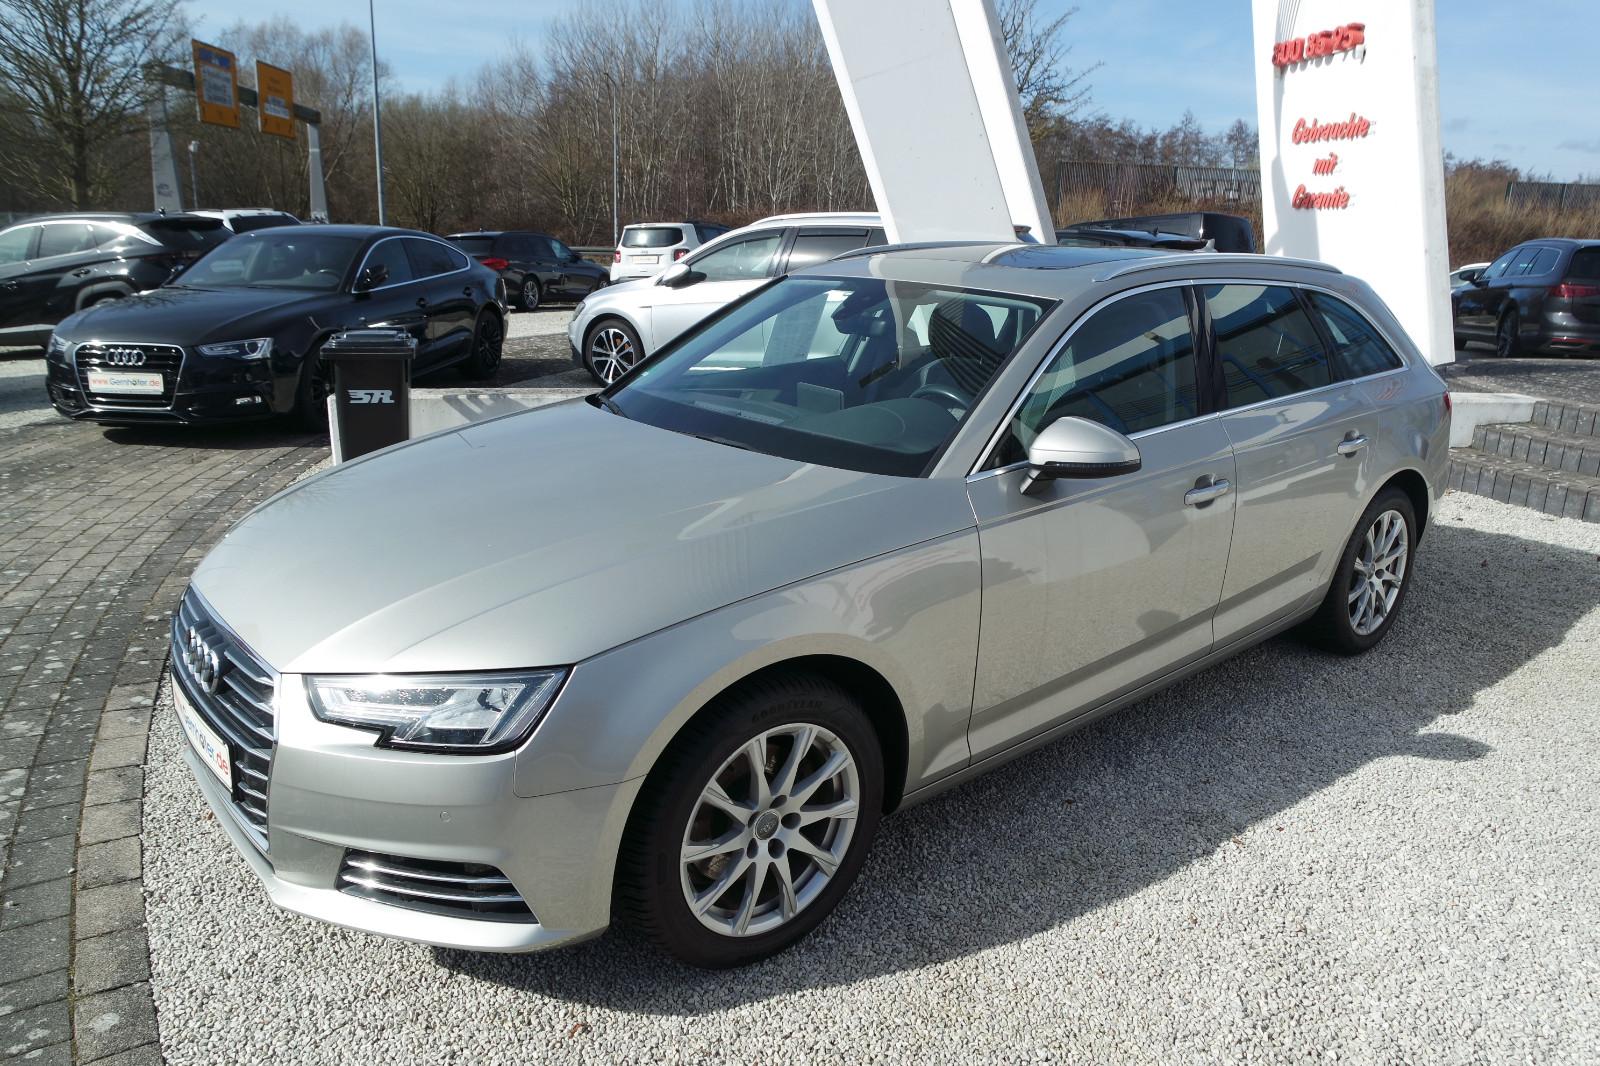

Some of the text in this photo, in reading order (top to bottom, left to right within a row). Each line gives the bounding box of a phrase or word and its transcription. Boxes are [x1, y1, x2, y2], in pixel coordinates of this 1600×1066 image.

[1292, 112, 1370, 145] Gebrauchte
[1312, 152, 1338, 176] mit
[1292, 184, 1350, 211] Garantie
